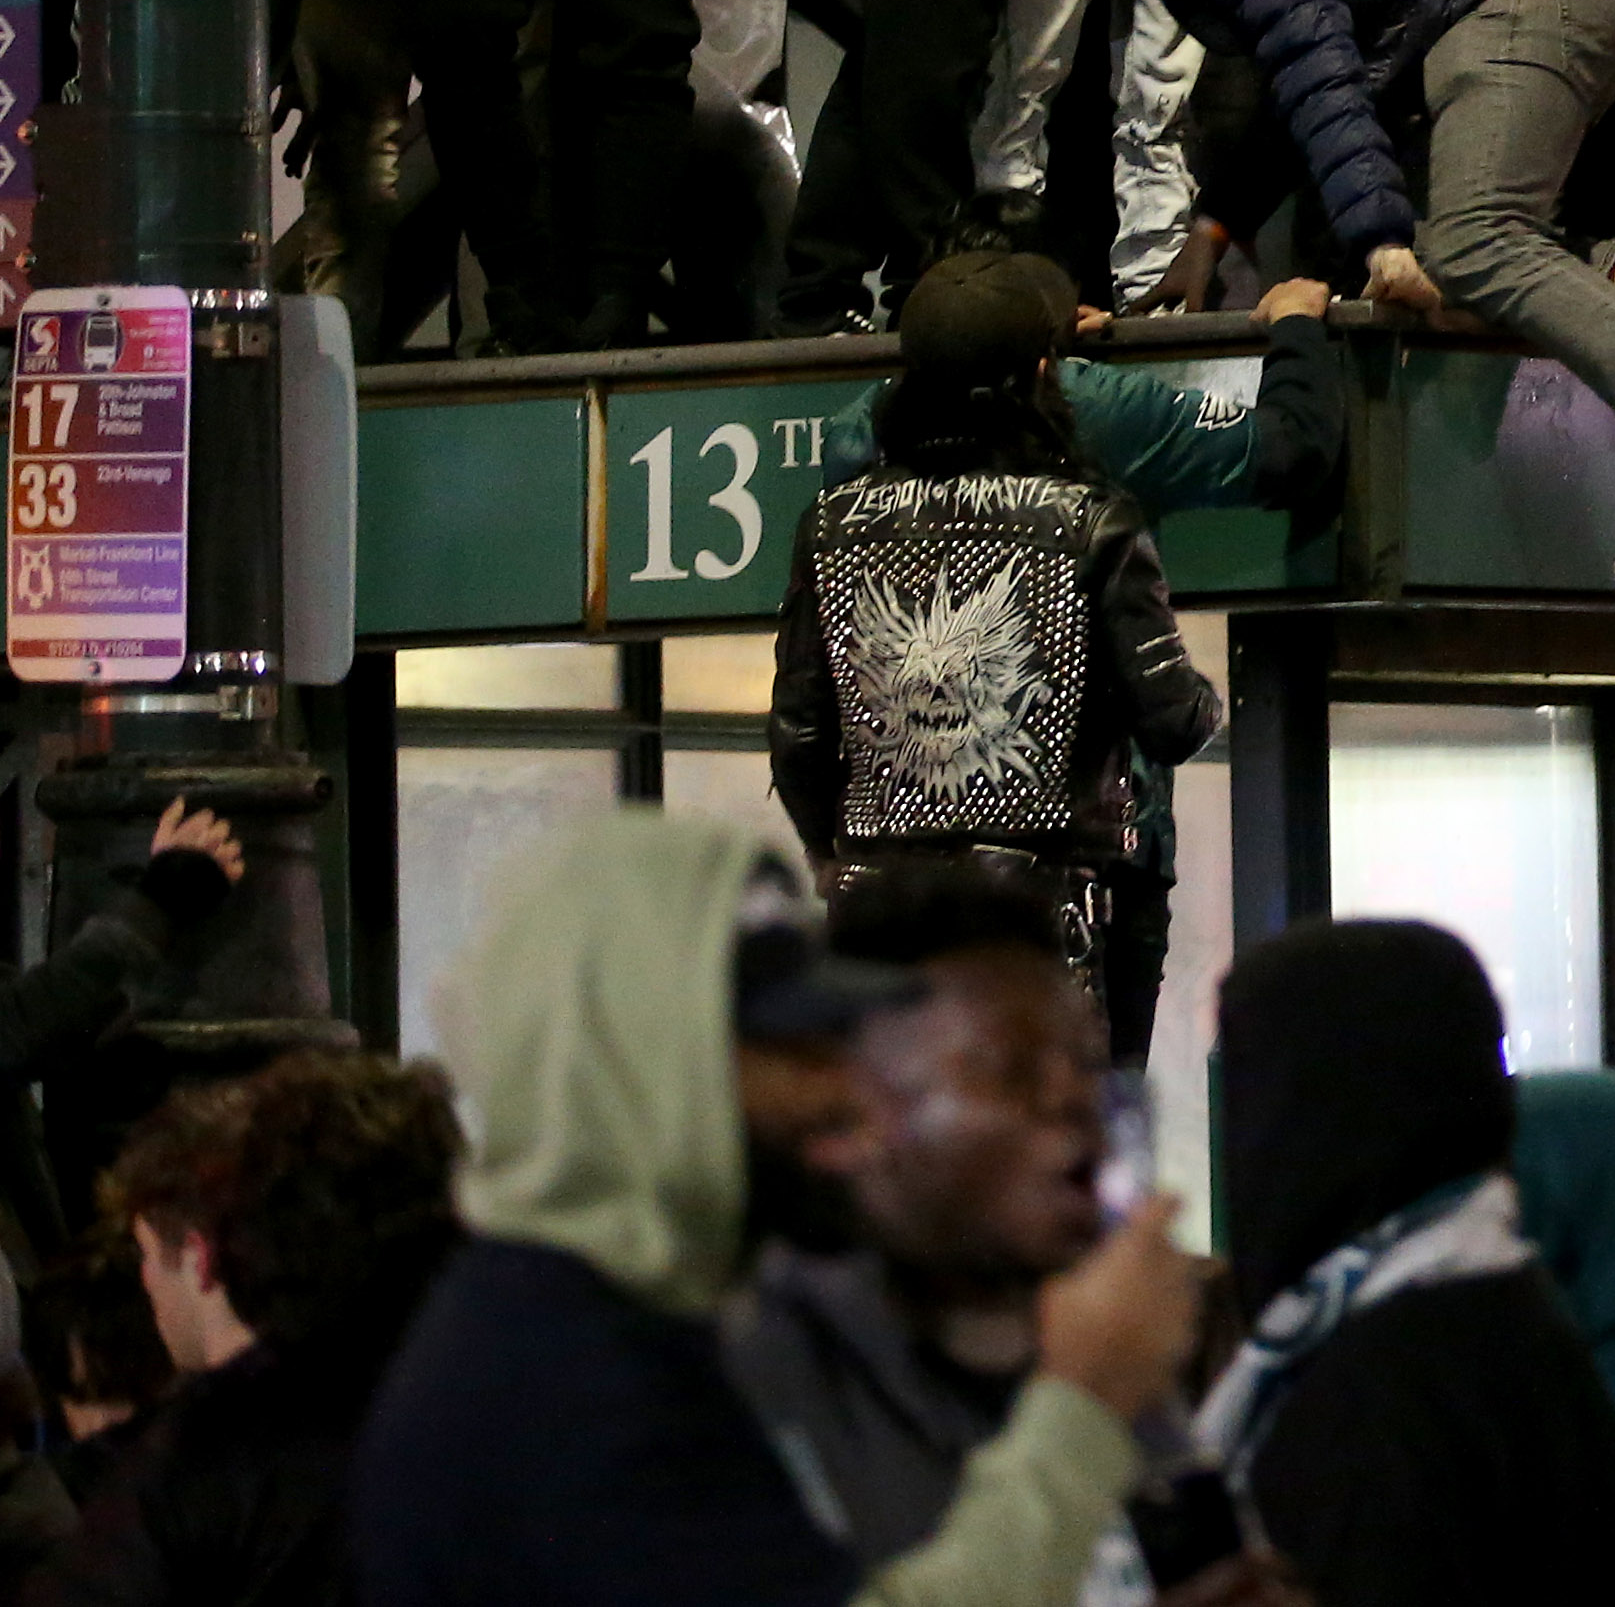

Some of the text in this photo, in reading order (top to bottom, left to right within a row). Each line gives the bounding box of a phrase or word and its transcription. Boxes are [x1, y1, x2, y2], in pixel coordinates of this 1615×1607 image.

[22, 383, 79, 448] 17
[18, 462, 77, 529] 33
[840, 477, 932, 525] LEGION
[952, 474, 1092, 518] PARASITES
